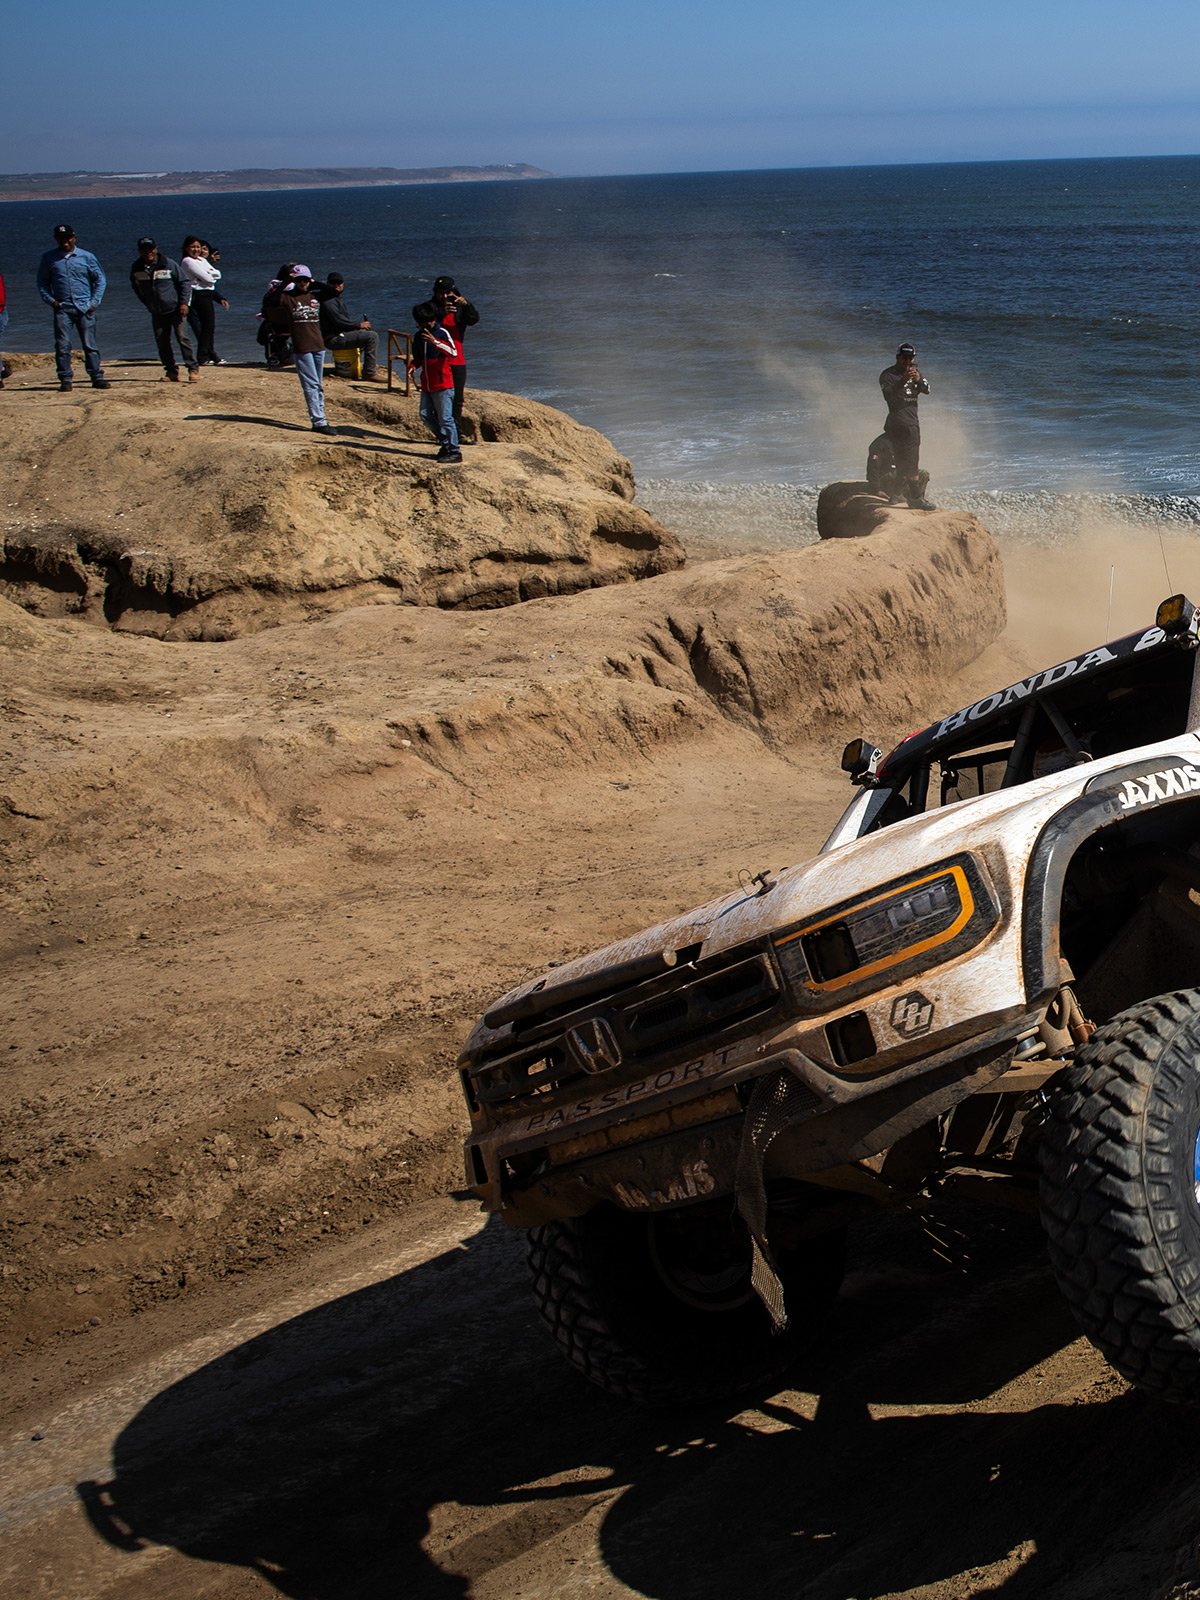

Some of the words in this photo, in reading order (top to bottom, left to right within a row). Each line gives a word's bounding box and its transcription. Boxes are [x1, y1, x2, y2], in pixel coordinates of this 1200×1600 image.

[933, 647, 1117, 740] HONDA
[1133, 626, 1168, 652] 8
[527, 1046, 738, 1131] PASSPORT
